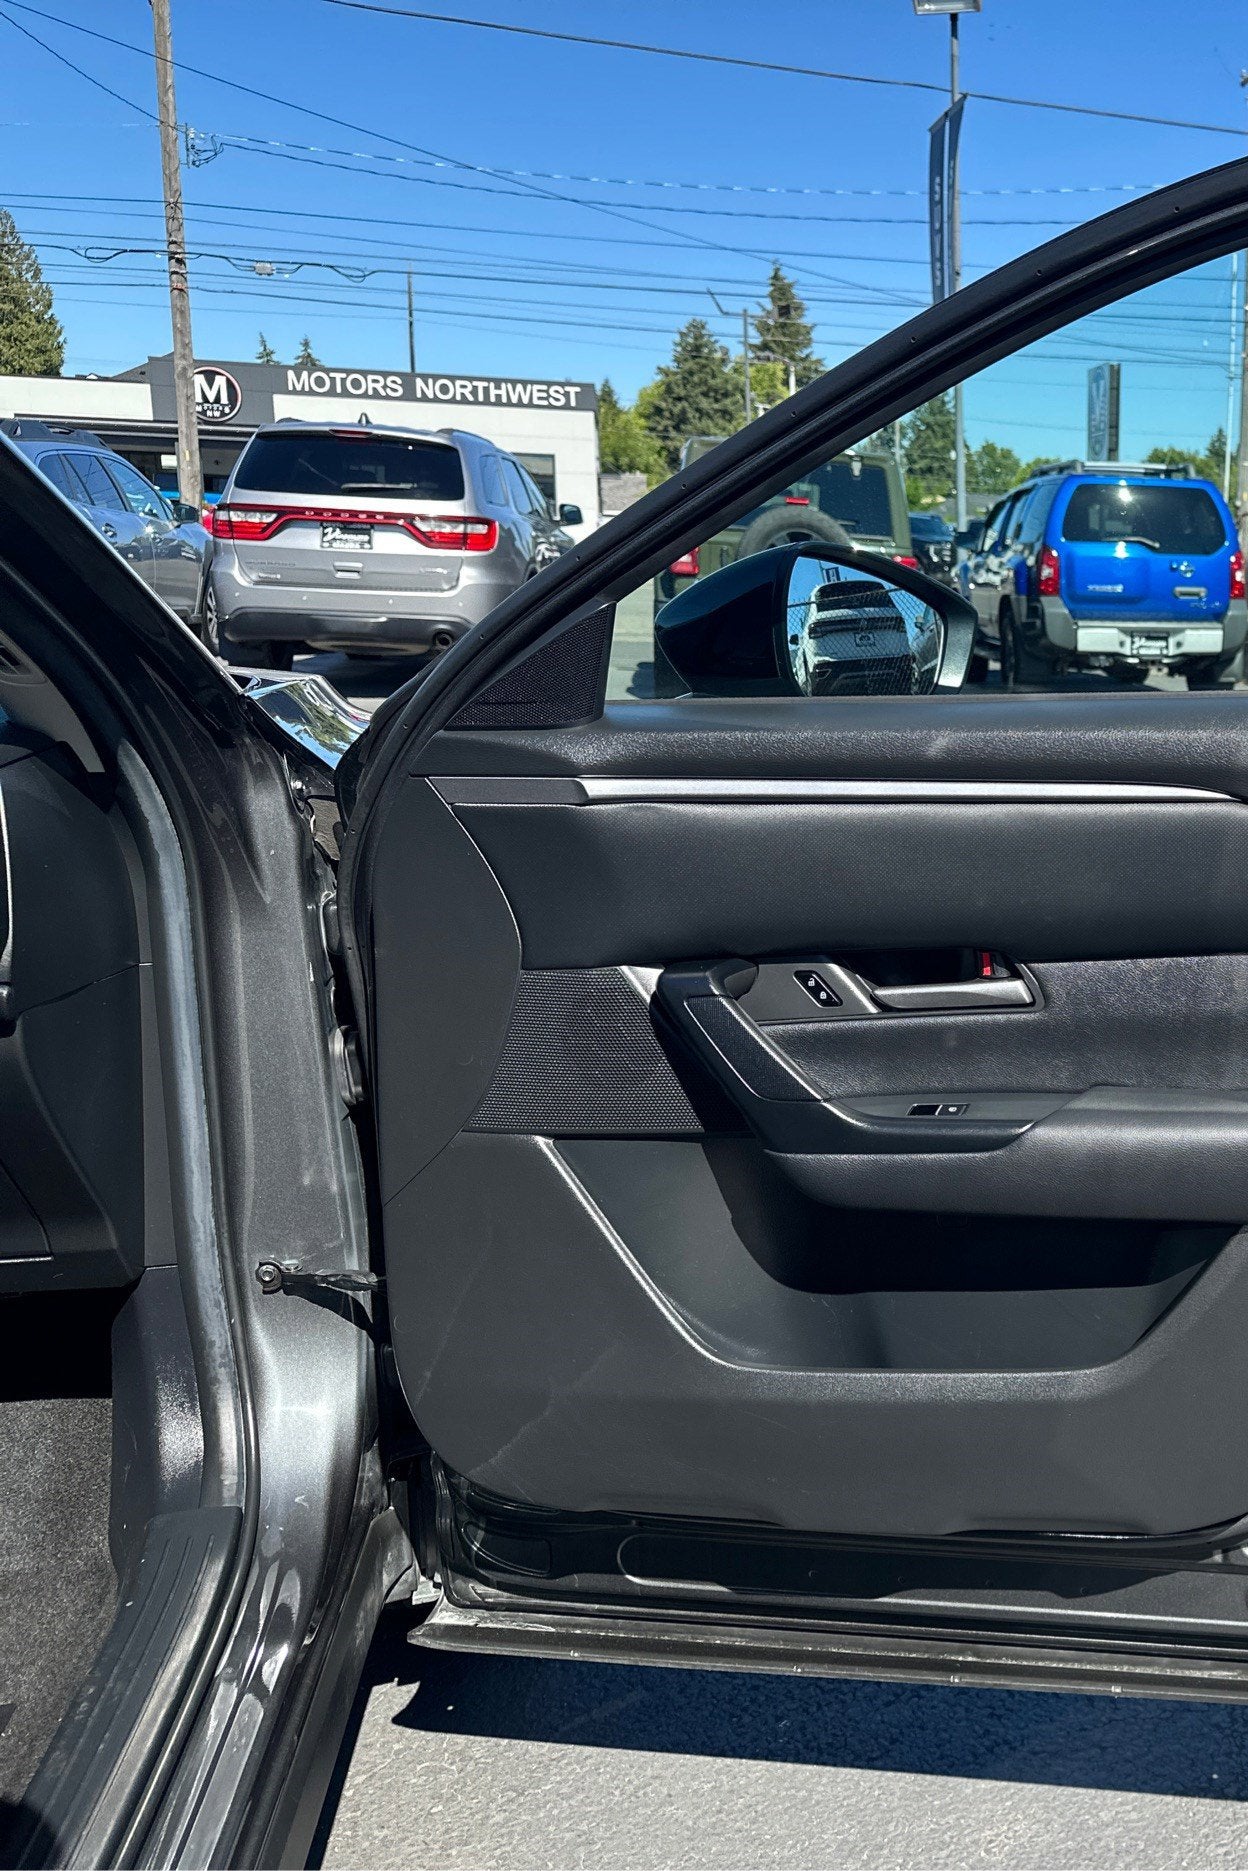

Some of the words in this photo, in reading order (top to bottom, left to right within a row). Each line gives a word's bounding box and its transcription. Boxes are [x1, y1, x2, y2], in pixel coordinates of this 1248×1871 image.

[193, 374, 229, 404] M
[287, 370, 404, 398] MOTORS
[415, 377, 582, 408] NORTHWEST
